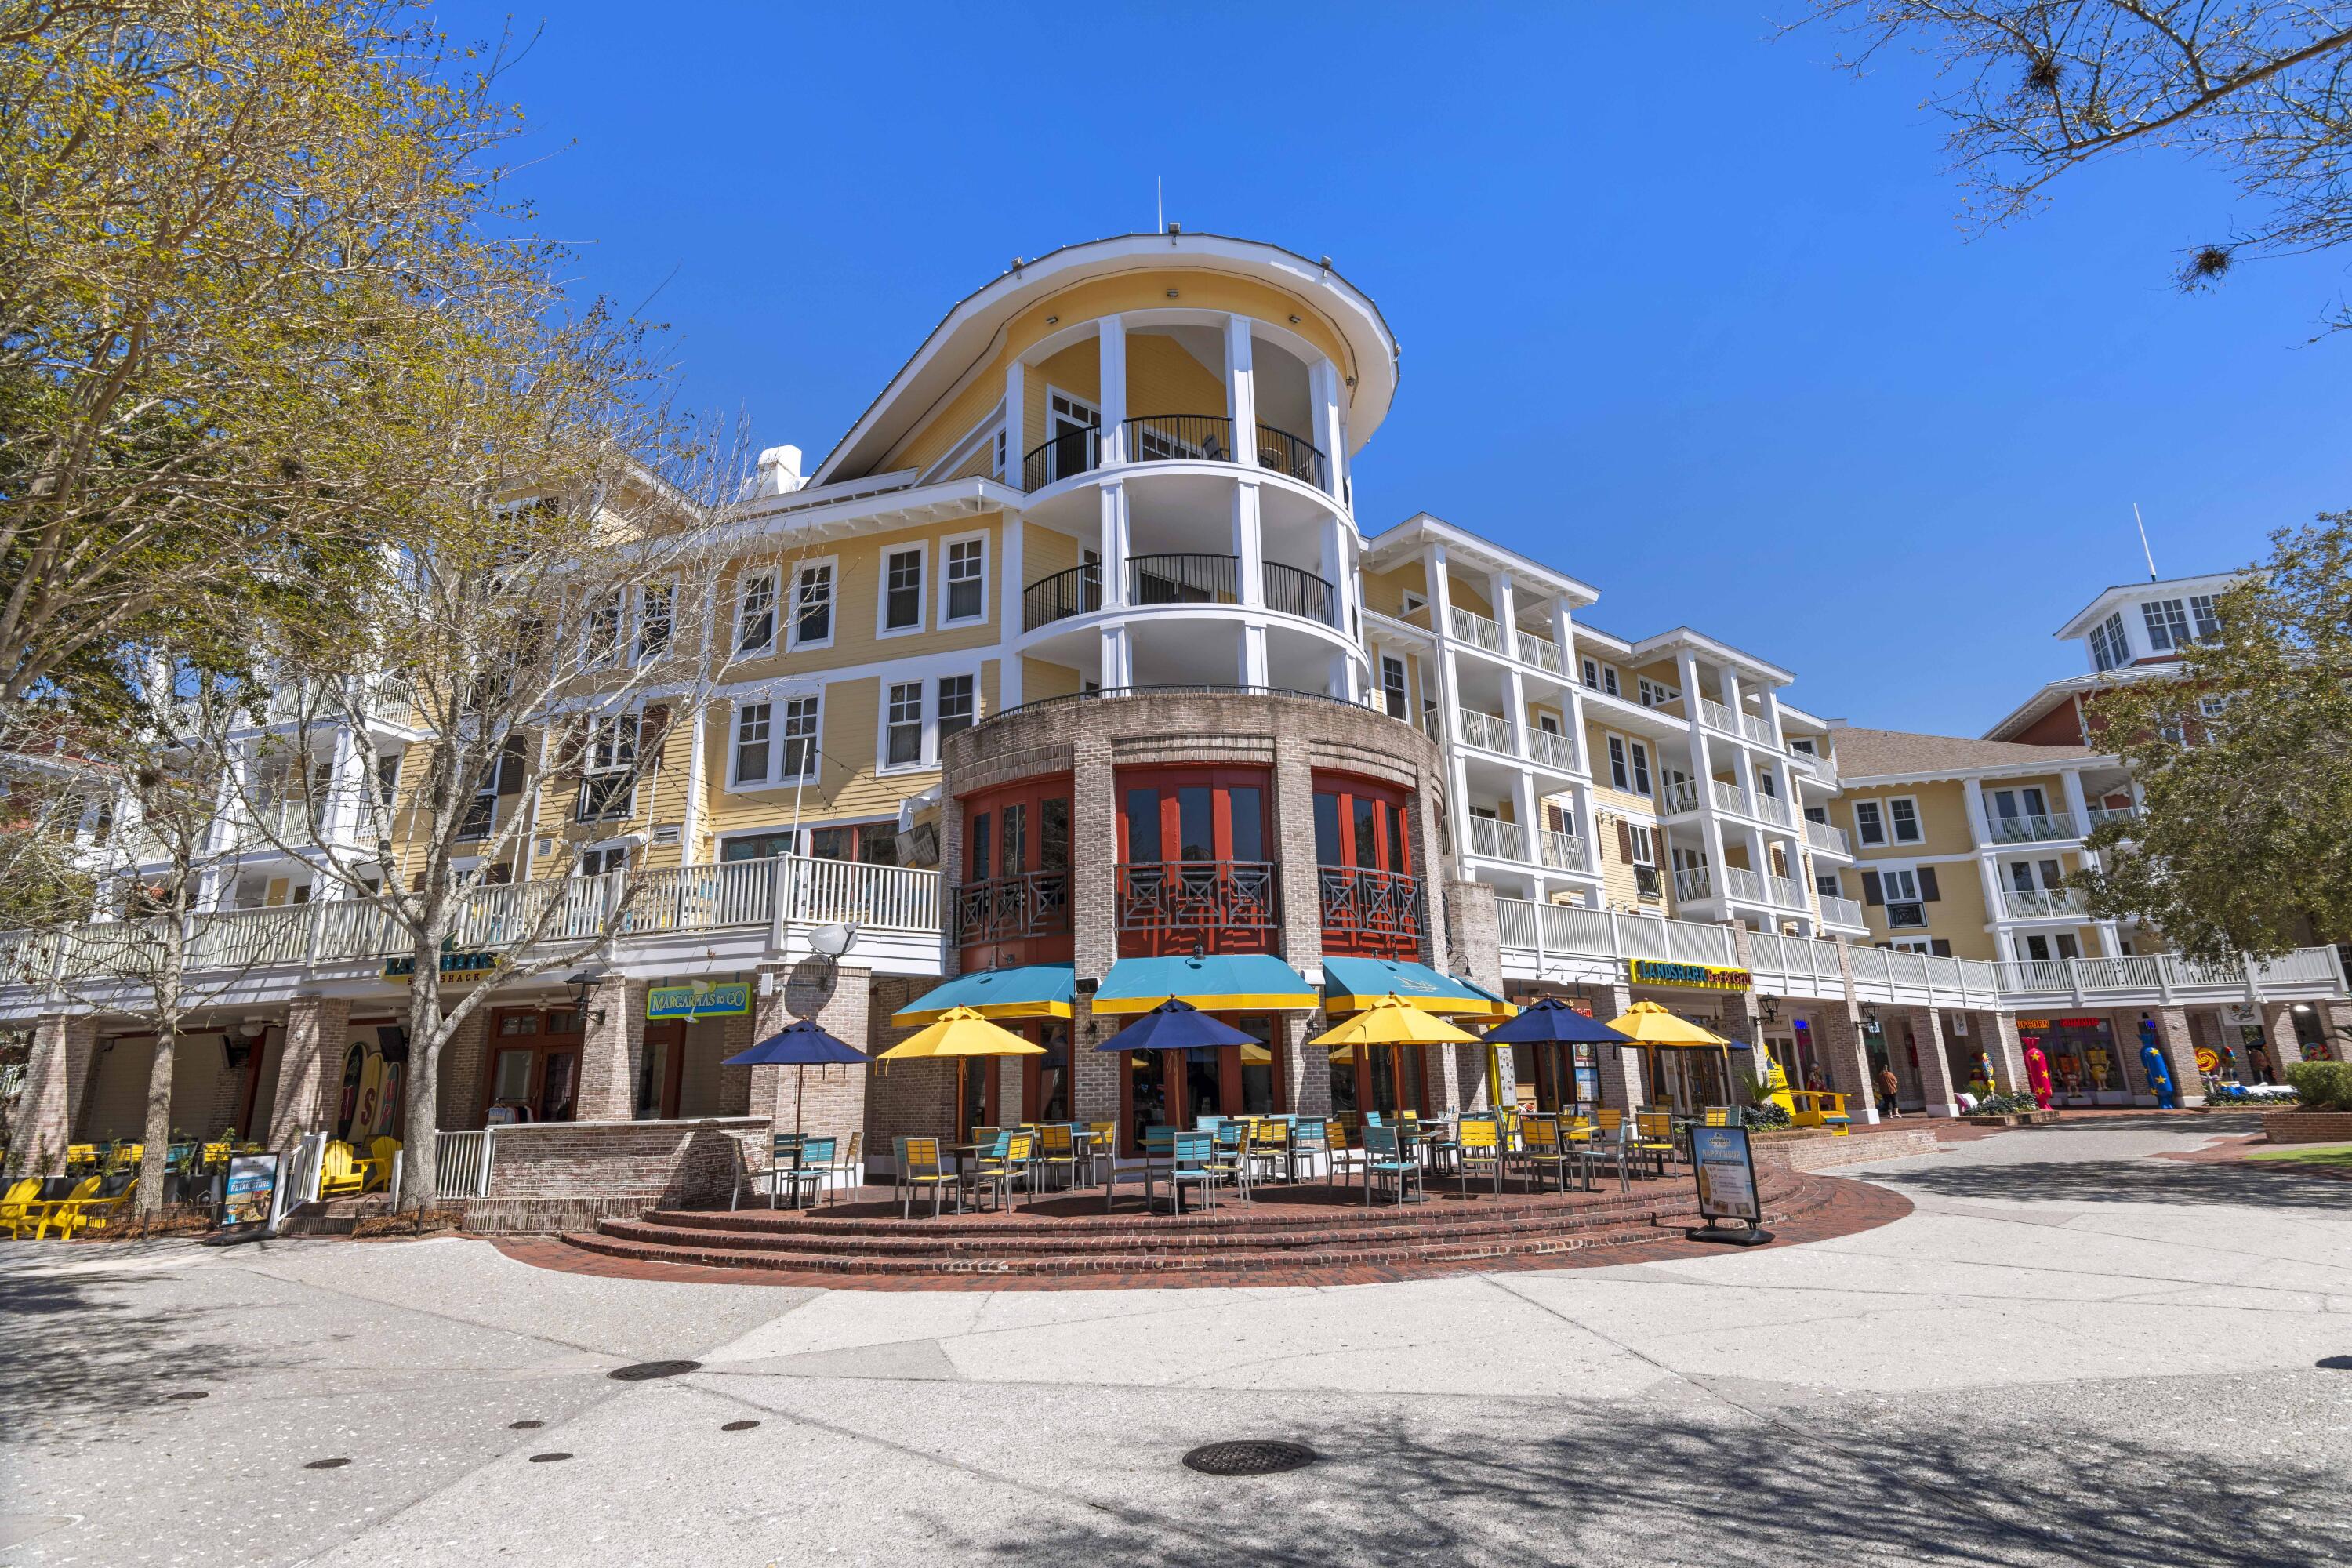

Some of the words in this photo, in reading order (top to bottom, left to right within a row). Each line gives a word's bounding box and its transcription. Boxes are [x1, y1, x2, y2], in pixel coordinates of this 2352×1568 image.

[440, 973, 481, 983] SHACK
[1640, 960, 1708, 982] LANDSHARK
[1707, 969, 1722, 982] Bar
[1724, 971, 1731, 983] &
[1733, 971, 1752, 985] Grill
[717, 996, 725, 1004] to
[726, 990, 746, 1007] GO
[2016, 1019, 2050, 1029] OPCORN
[1702, 1149, 1722, 1158] HAPPY
[1723, 1150, 1741, 1160] HOUR
[230, 1183, 251, 1192] RETAIL
[252, 1180, 270, 1189] STORE
